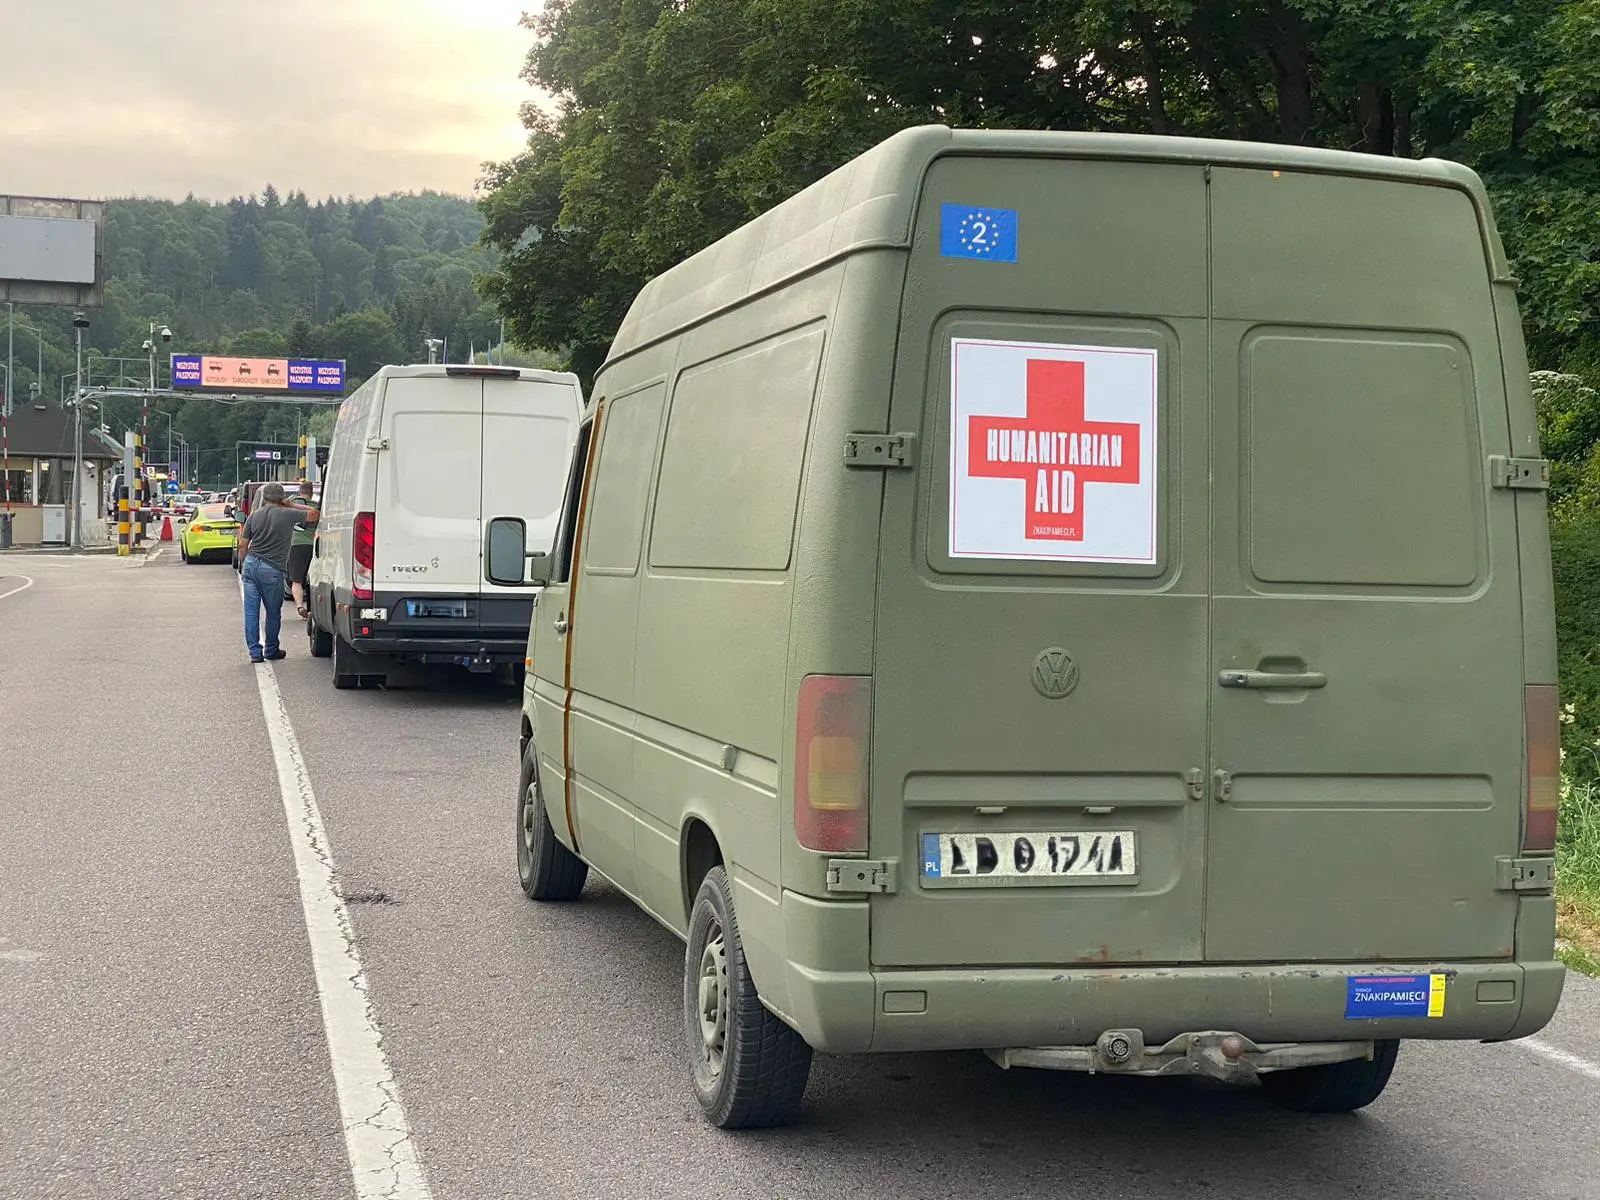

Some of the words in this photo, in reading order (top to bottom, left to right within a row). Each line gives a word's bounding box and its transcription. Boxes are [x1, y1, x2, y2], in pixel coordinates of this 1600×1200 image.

[971, 222, 987, 244] 2
[986, 428, 1123, 467] HUMANITARIAN
[1034, 468, 1076, 514] AID
[392, 564, 428, 573] IVECO
[925, 862, 939, 872] PL
[1354, 992, 1425, 1003] ZNAKIPAMIĘCI
